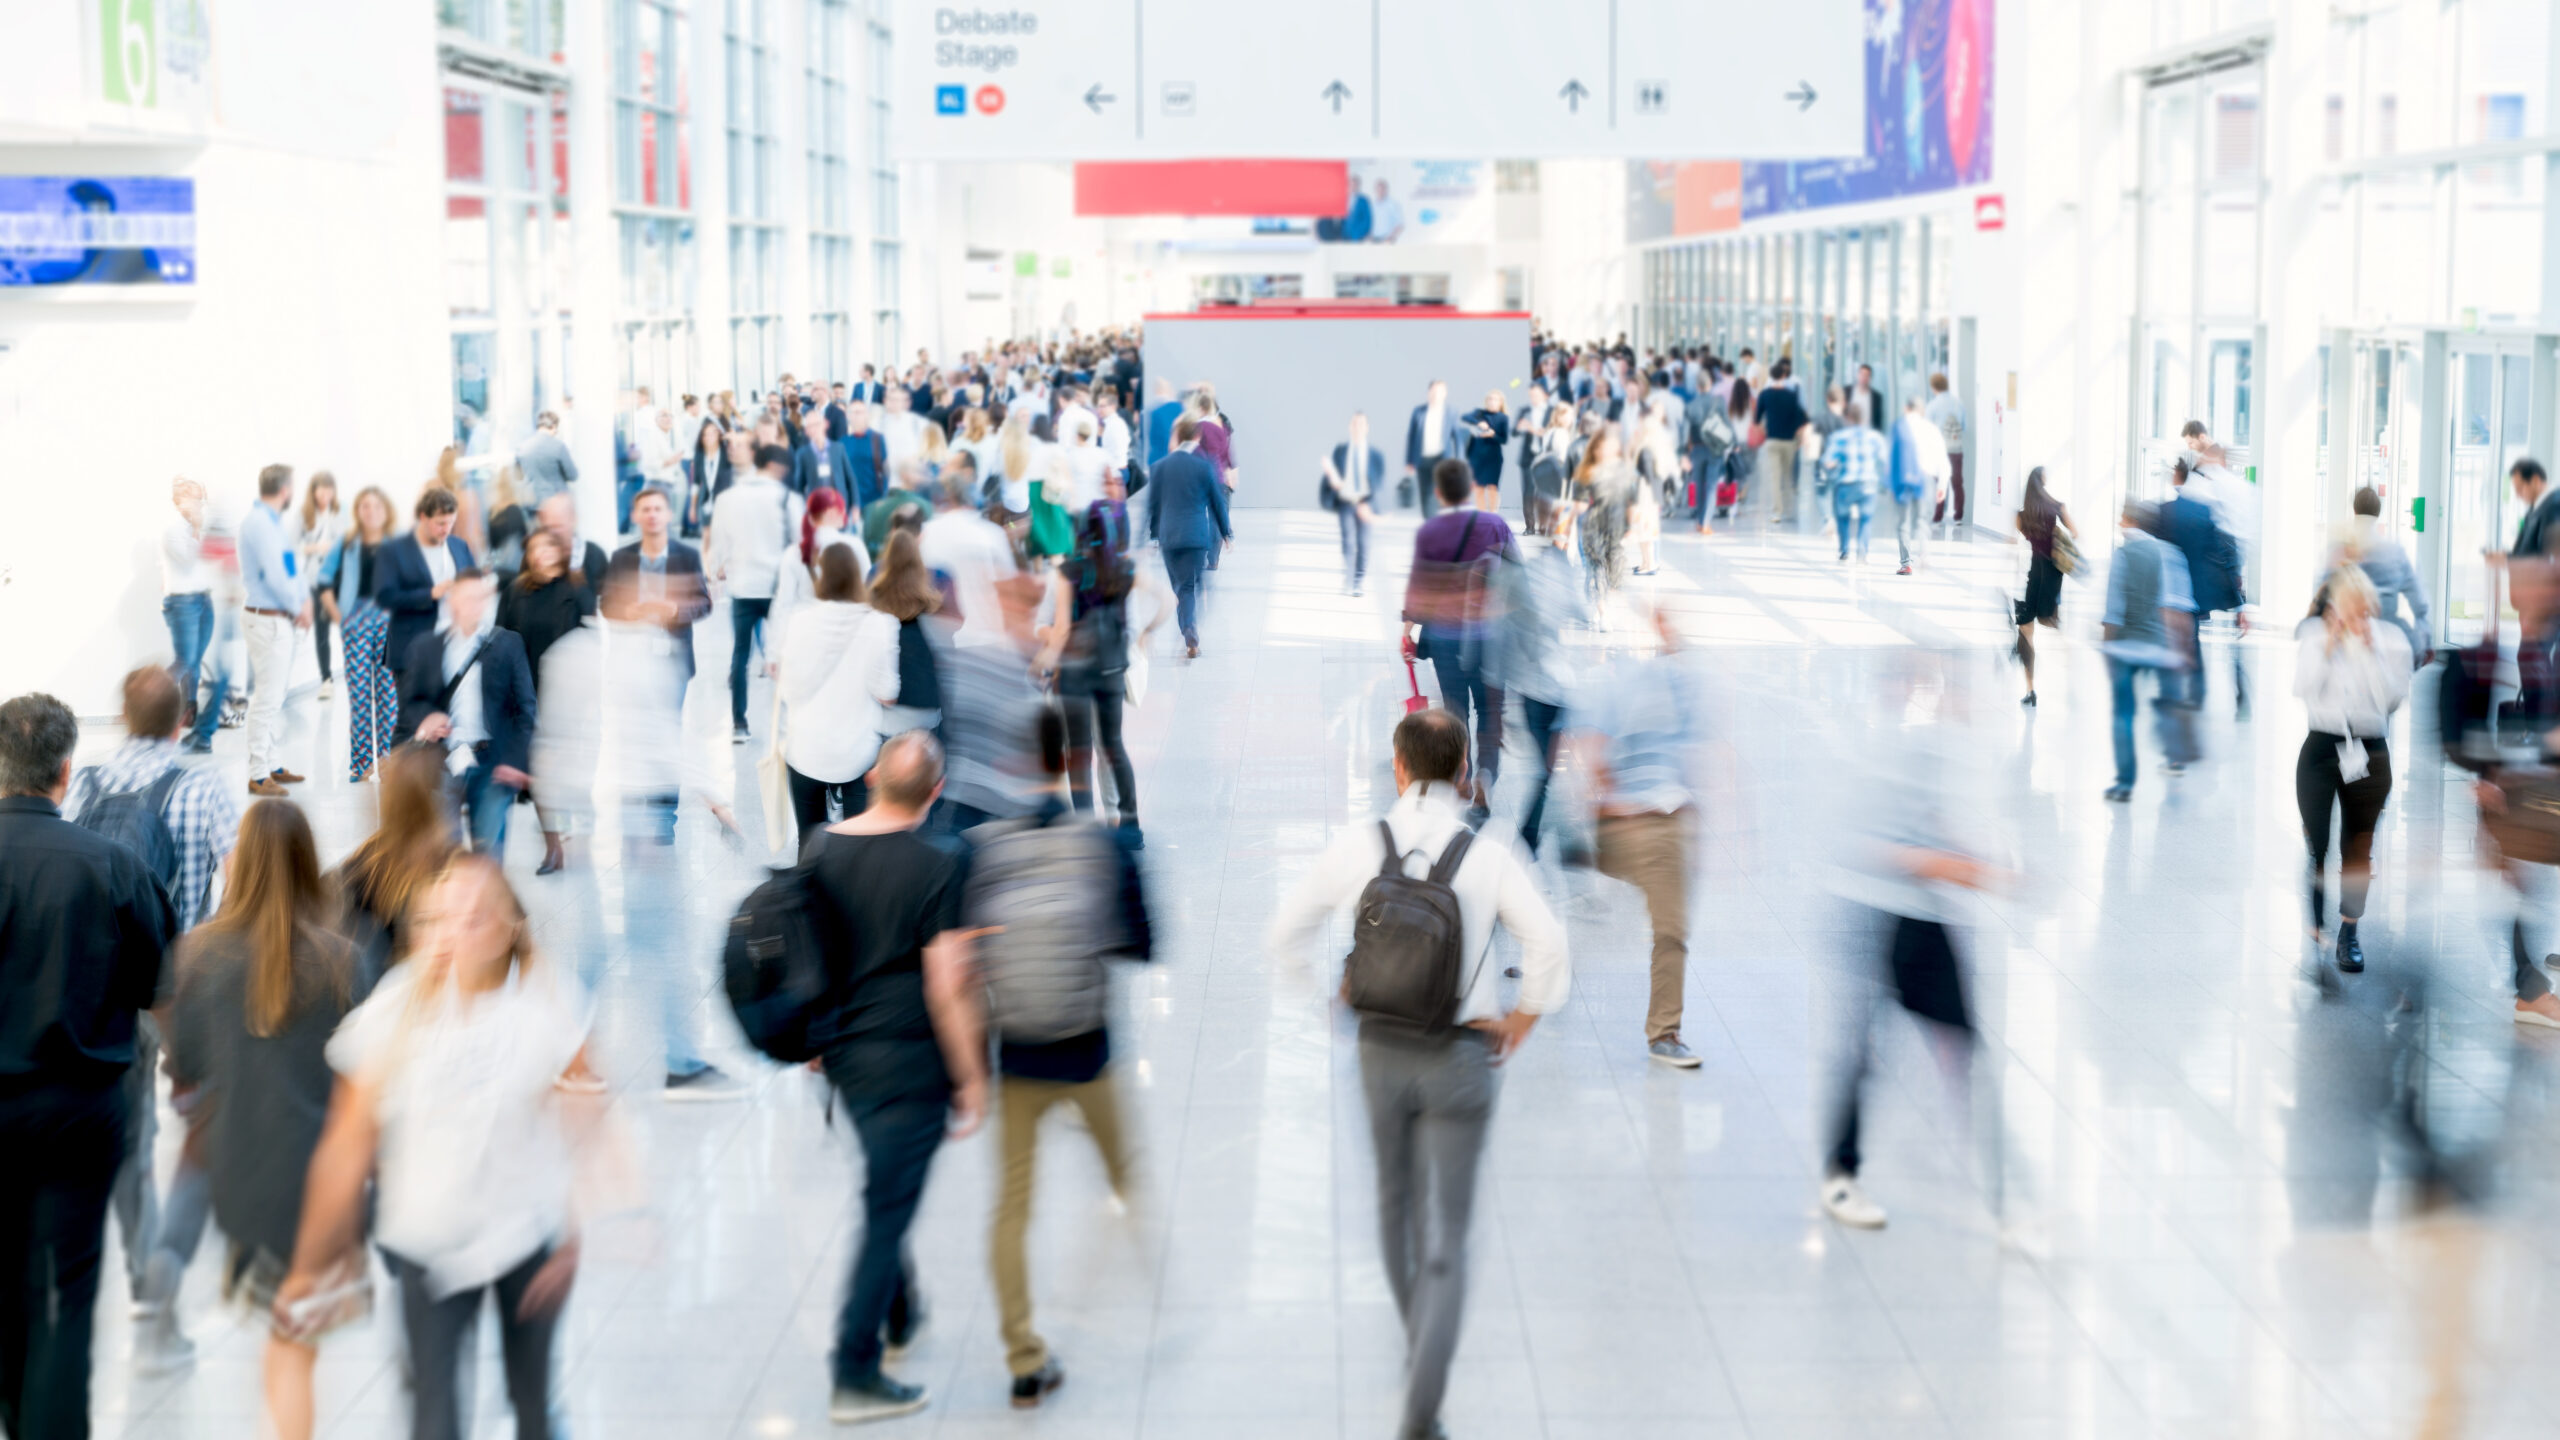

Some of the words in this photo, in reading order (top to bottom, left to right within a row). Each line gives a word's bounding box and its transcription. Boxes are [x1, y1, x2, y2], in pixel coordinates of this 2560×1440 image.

[936, 9, 1037, 35] Debate
[121, 0, 150, 106] 6
[936, 41, 1018, 72] Stage
